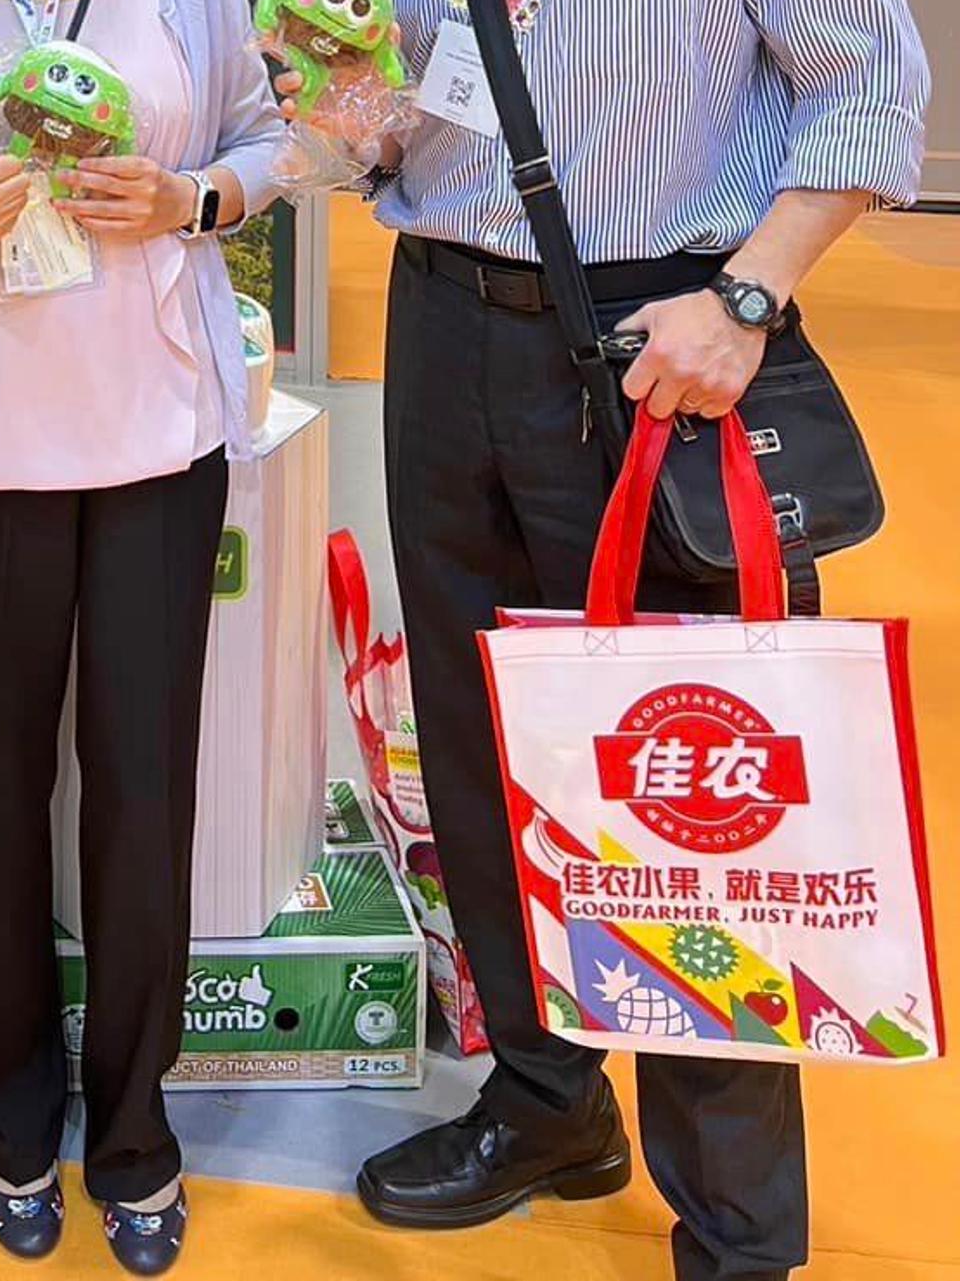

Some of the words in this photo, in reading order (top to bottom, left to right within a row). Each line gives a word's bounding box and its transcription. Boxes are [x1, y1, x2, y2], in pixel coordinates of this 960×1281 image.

[628, 737, 777, 801] 佳农
[738, 907, 795, 925] JUST
[802, 909, 879, 930] HAPPY
[200, 1060, 221, 1072] OF
[227, 1059, 300, 1073] THAILAND
[348, 1058, 370, 1072] 12
